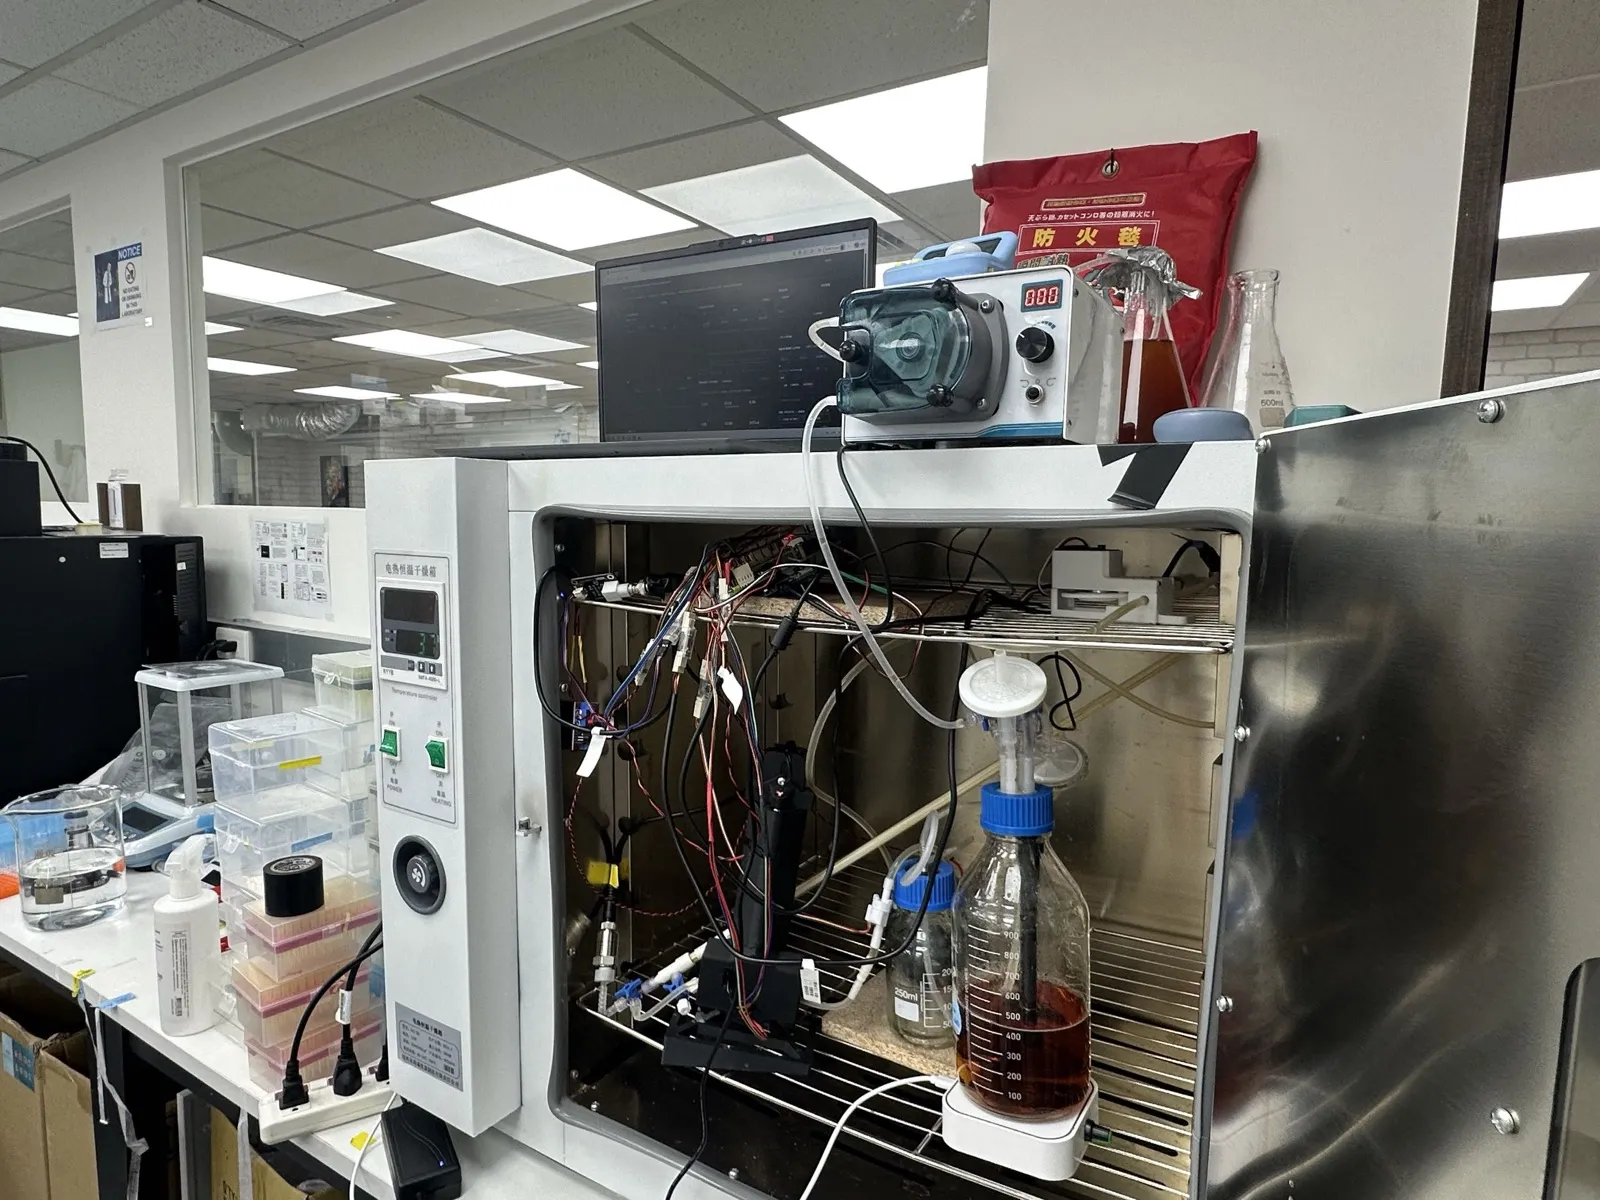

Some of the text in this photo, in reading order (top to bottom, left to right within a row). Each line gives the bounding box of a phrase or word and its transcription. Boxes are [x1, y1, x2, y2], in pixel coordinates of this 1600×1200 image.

[118, 245, 141, 260] NOTICE
[1024, 286, 1059, 306] 000
[1003, 931, 1019, 940] 900
[1003, 951, 1020, 960] 800
[1004, 971, 1020, 980] 700
[894, 987, 919, 1002] 250ml
[1005, 991, 1021, 1000] 600
[1005, 1011, 1021, 1021] 500
[1005, 1032, 1022, 1041] 400
[1006, 1052, 1022, 1061] 300
[1006, 1071, 1022, 1081] 200
[1007, 1091, 1022, 1101] 100
